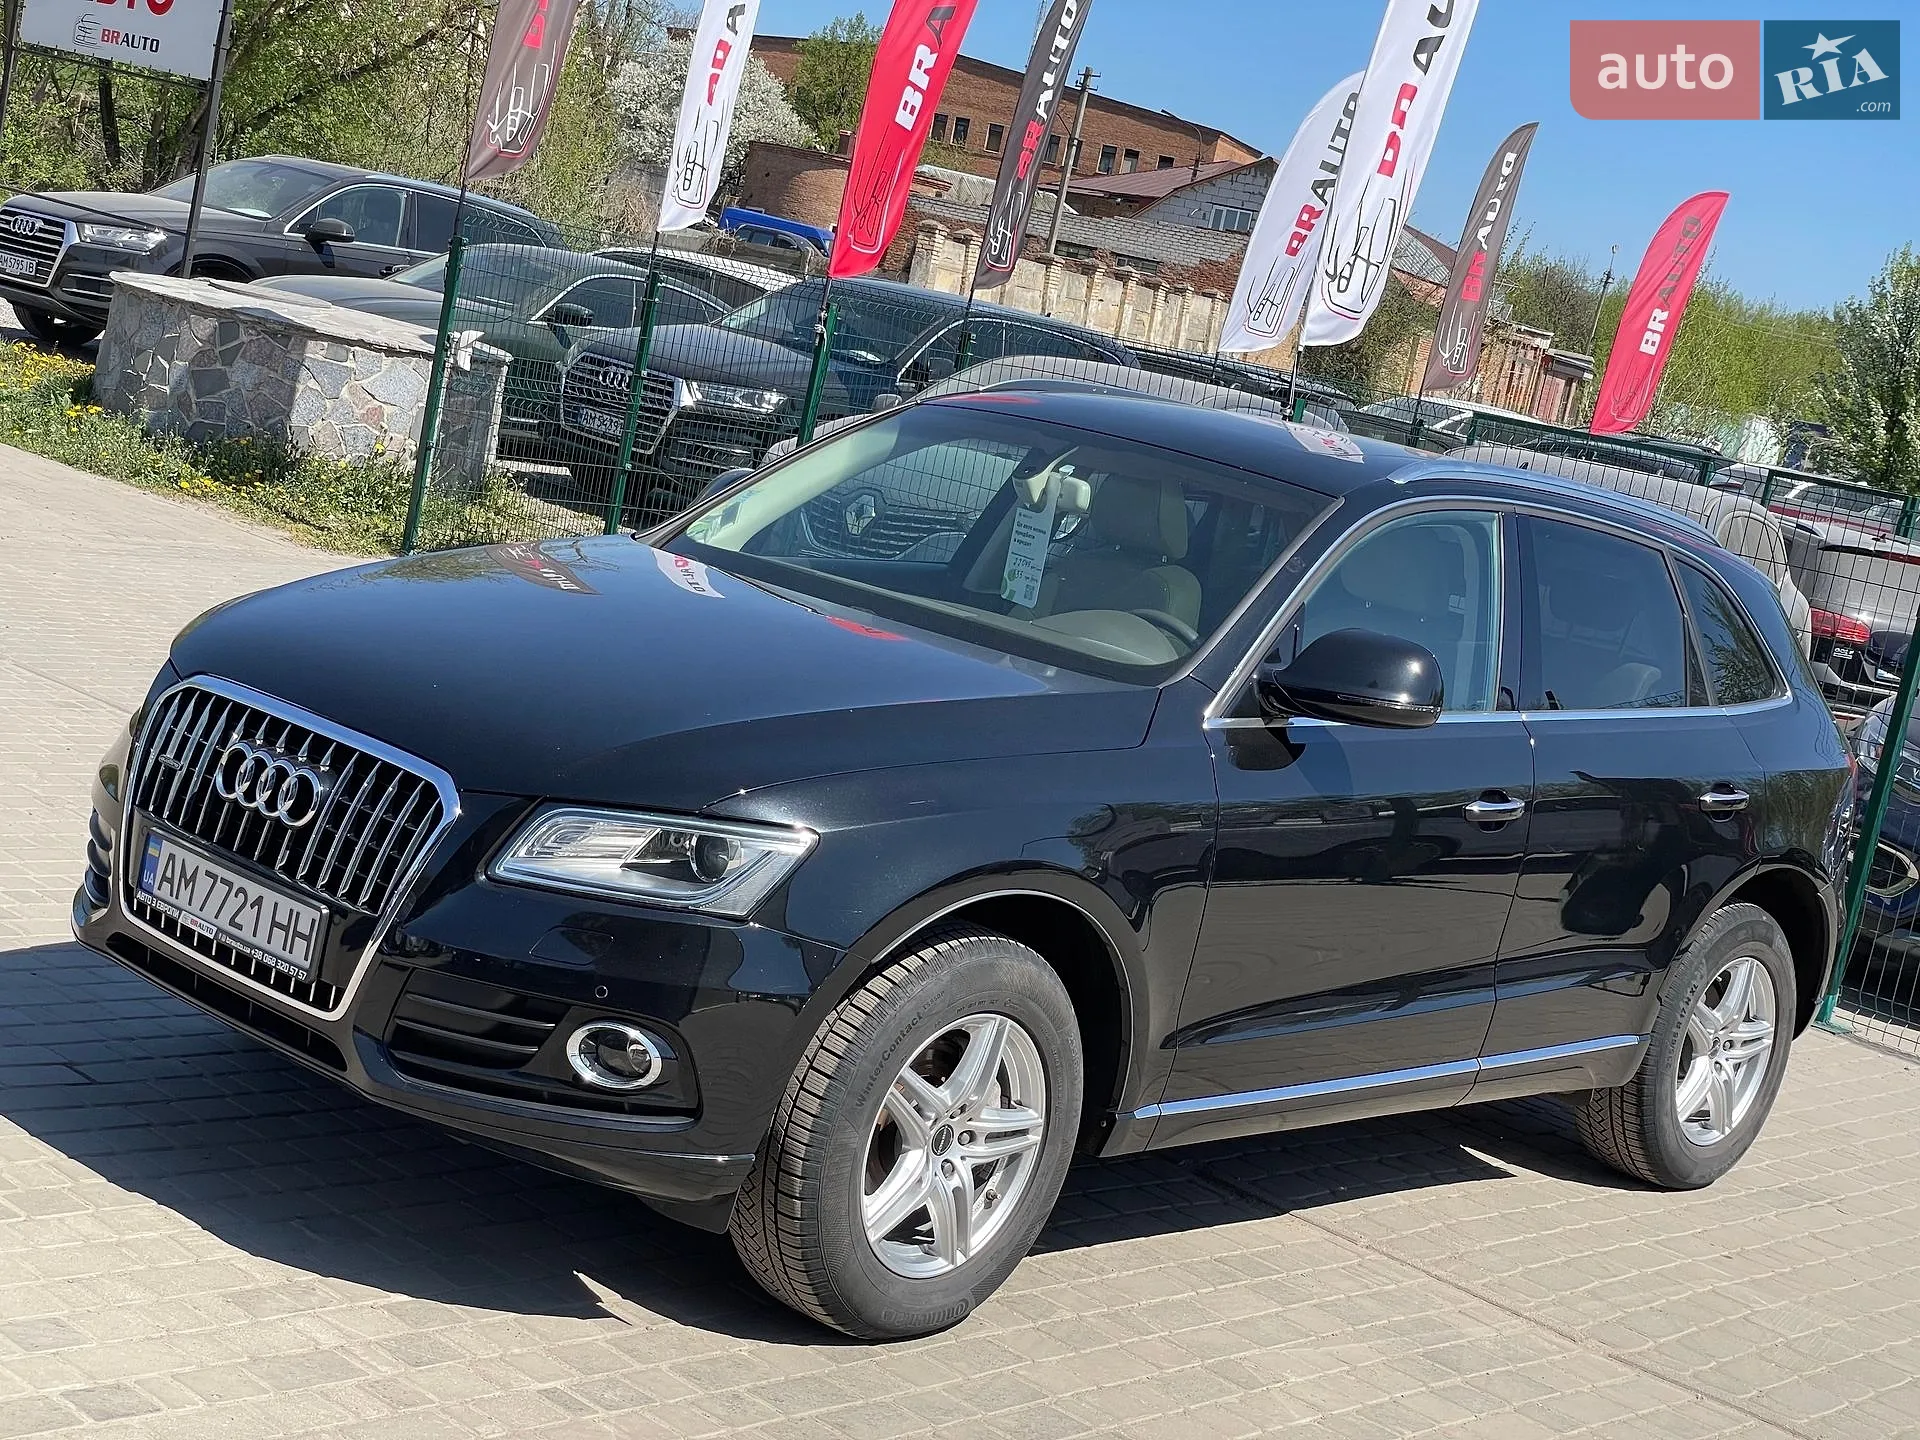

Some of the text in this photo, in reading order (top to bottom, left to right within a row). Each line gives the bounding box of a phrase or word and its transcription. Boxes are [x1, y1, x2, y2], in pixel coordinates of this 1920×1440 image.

[101, 28, 160, 53] BRAUTO
[1639, 215, 1702, 356] BRAUTO
[143, 870, 155, 887] UA
